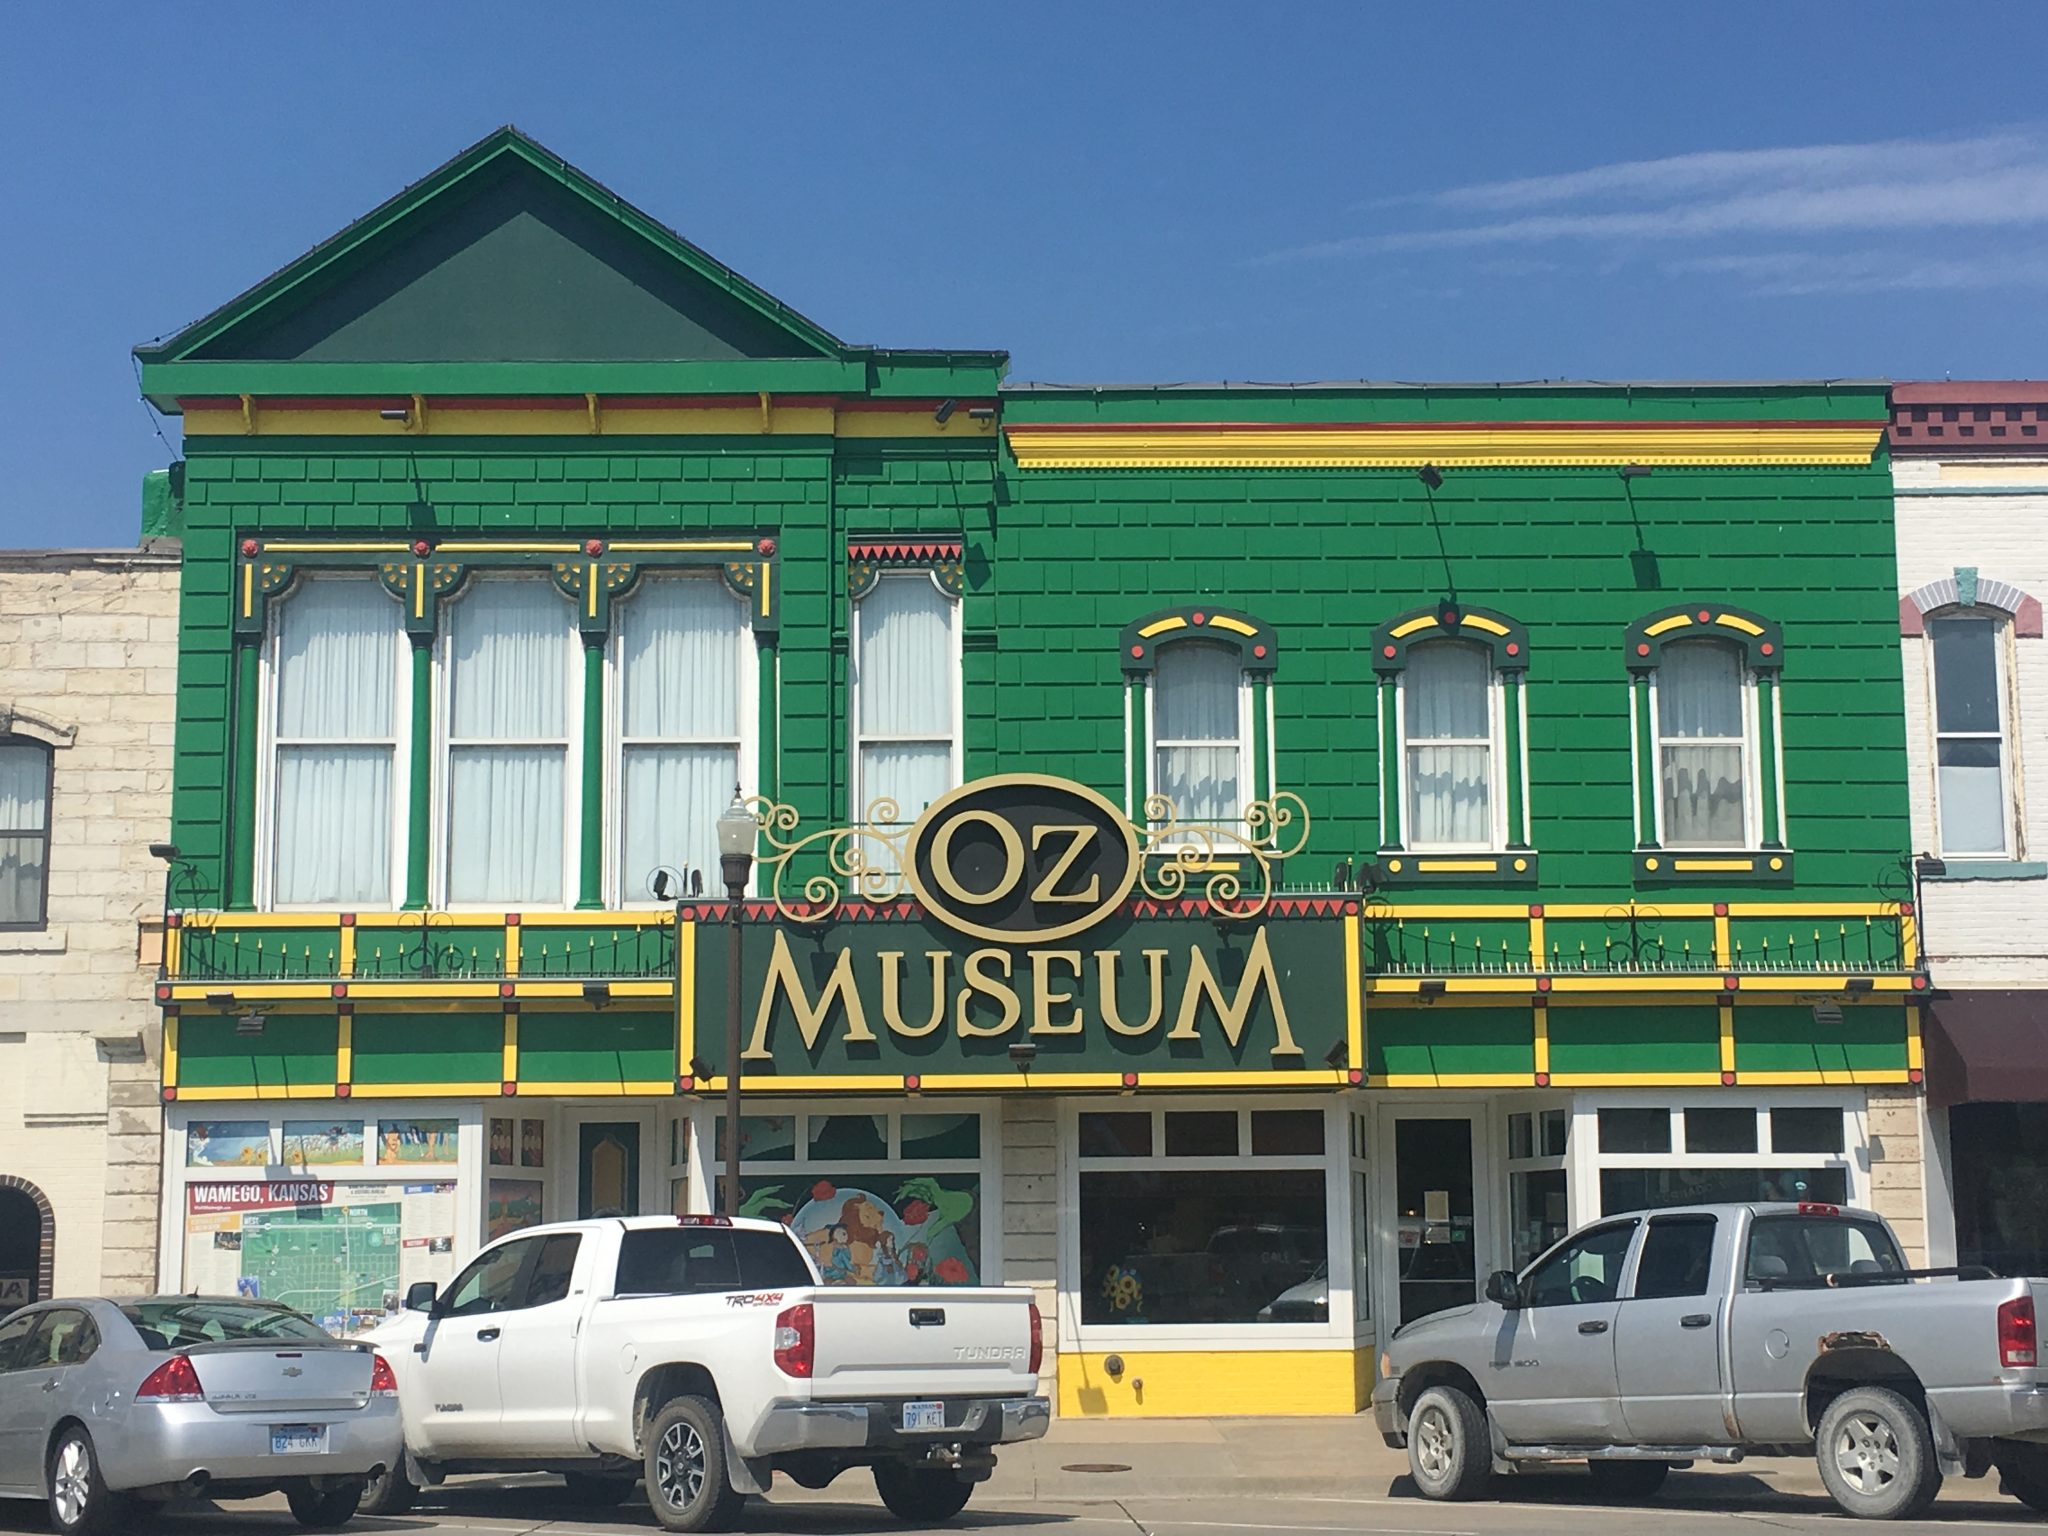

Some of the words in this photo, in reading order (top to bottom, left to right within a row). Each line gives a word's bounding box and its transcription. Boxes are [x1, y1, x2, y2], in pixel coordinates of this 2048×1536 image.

[929, 809, 1101, 904] OZ
[739, 925, 1304, 1060] MUSEUM
[194, 1185, 264, 1203] WAMEGO,
[269, 1183, 329, 1202] KANSAS
[953, 1347, 1026, 1360] TUNDRA
[905, 1411, 921, 1428] 791
